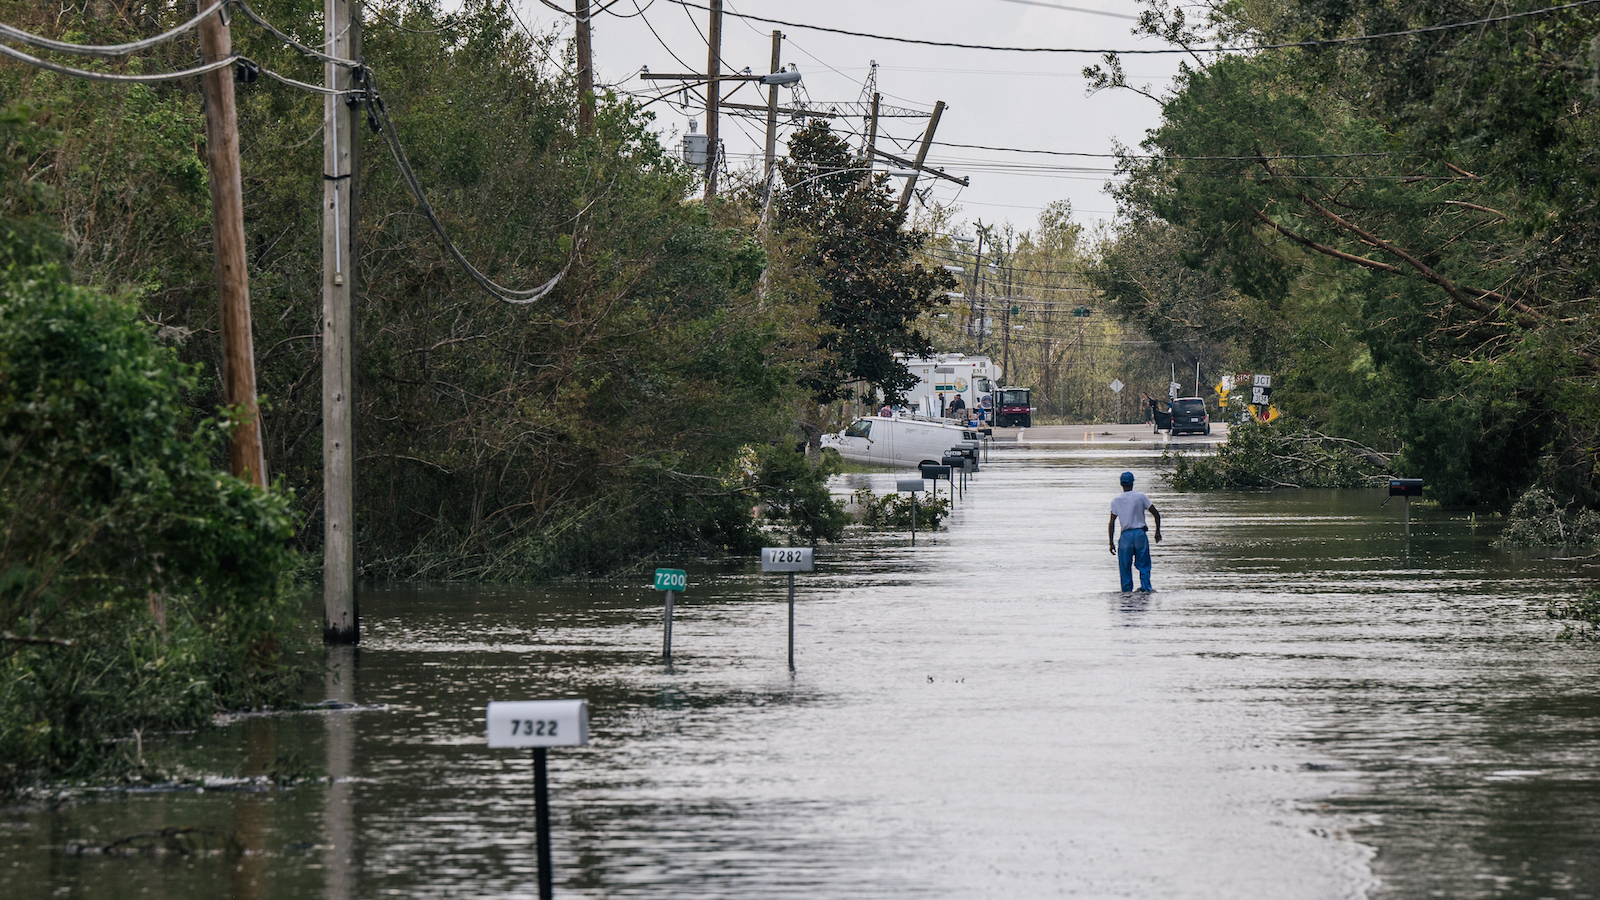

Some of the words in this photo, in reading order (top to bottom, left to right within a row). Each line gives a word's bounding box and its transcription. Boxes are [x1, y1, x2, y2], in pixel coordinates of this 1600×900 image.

[1255, 376, 1270, 384] JCT
[771, 550, 802, 563] 7282
[655, 572, 685, 586] 7200
[511, 720, 558, 736] 7322
